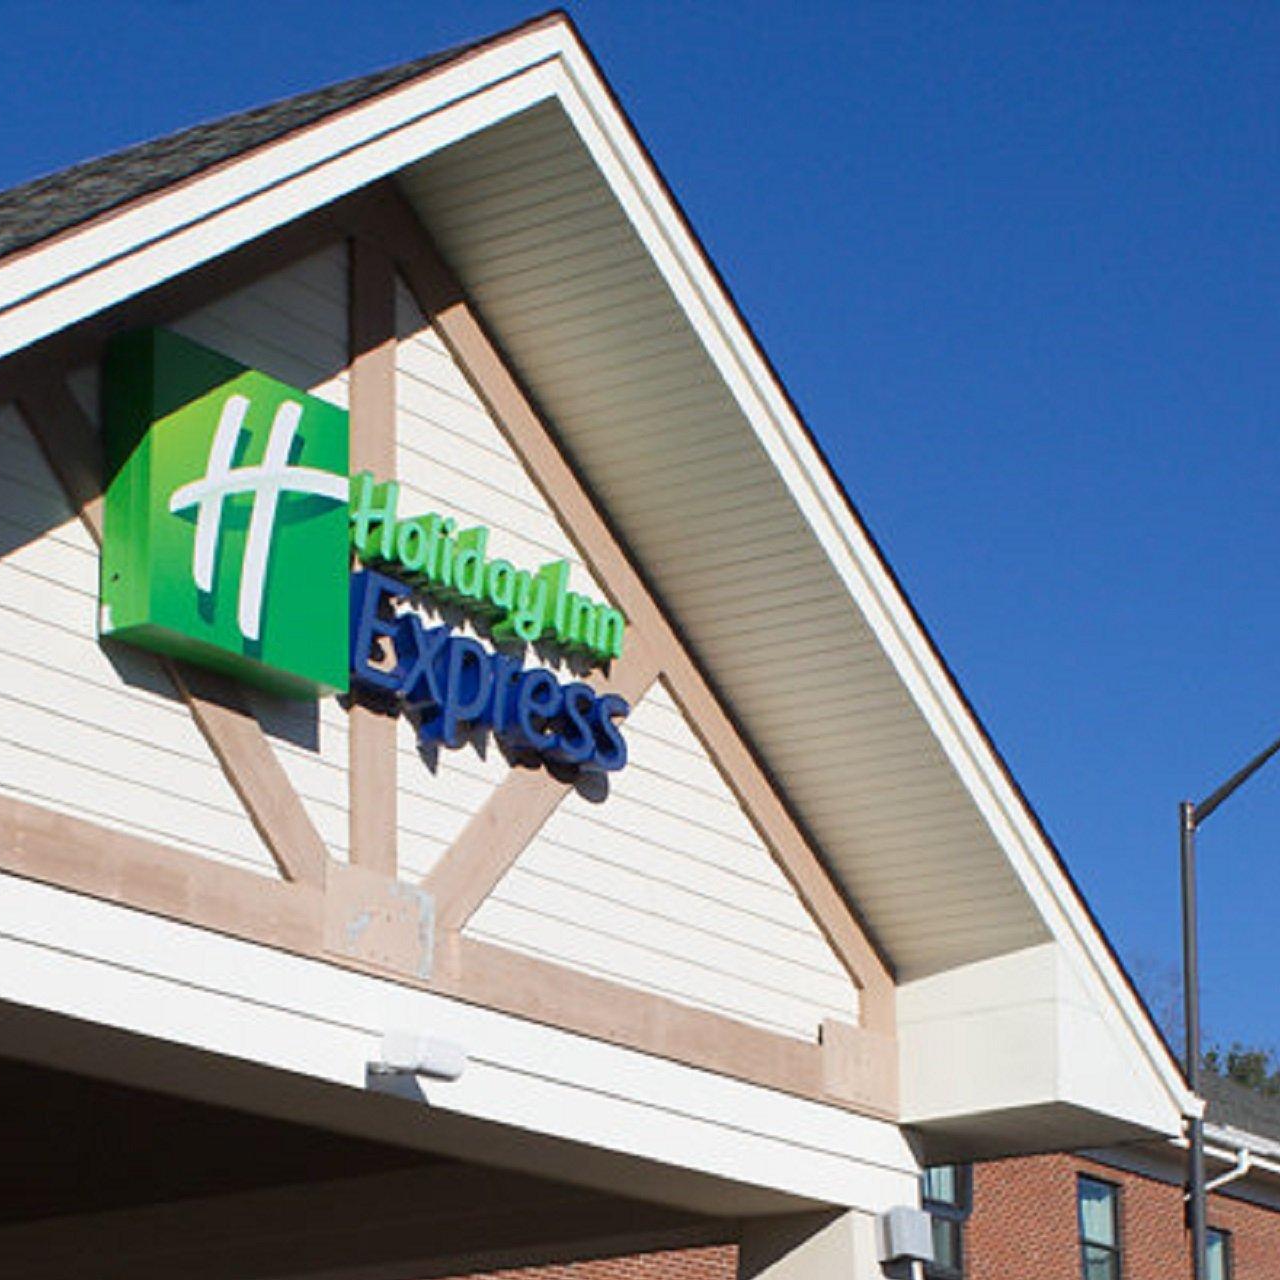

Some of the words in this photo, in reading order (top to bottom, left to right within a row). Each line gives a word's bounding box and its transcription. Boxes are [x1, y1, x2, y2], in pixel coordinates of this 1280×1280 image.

[169, 394, 350, 641] H
[350, 471, 548, 641] Holiday
[552, 558, 625, 658] Inn
[351, 570, 630, 772] Express
